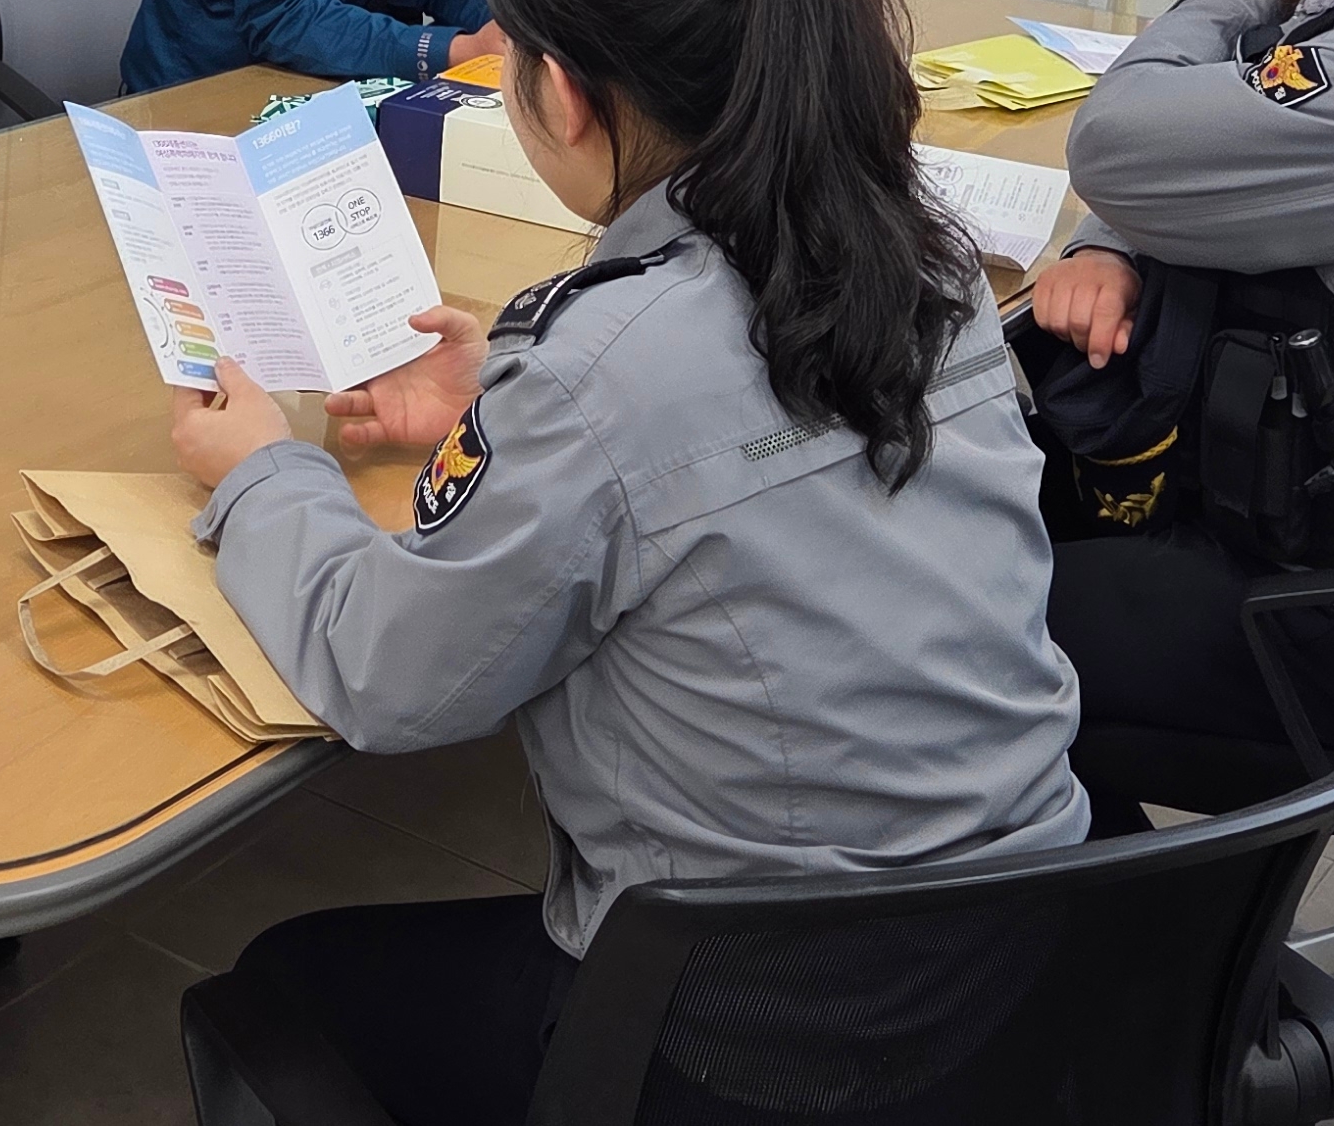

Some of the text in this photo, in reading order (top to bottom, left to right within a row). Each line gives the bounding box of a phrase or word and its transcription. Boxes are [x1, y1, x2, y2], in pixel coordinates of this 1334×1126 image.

[347, 195, 367, 211] ONE
[349, 206, 372, 223] STOP
[312, 224, 337, 242] 1366
